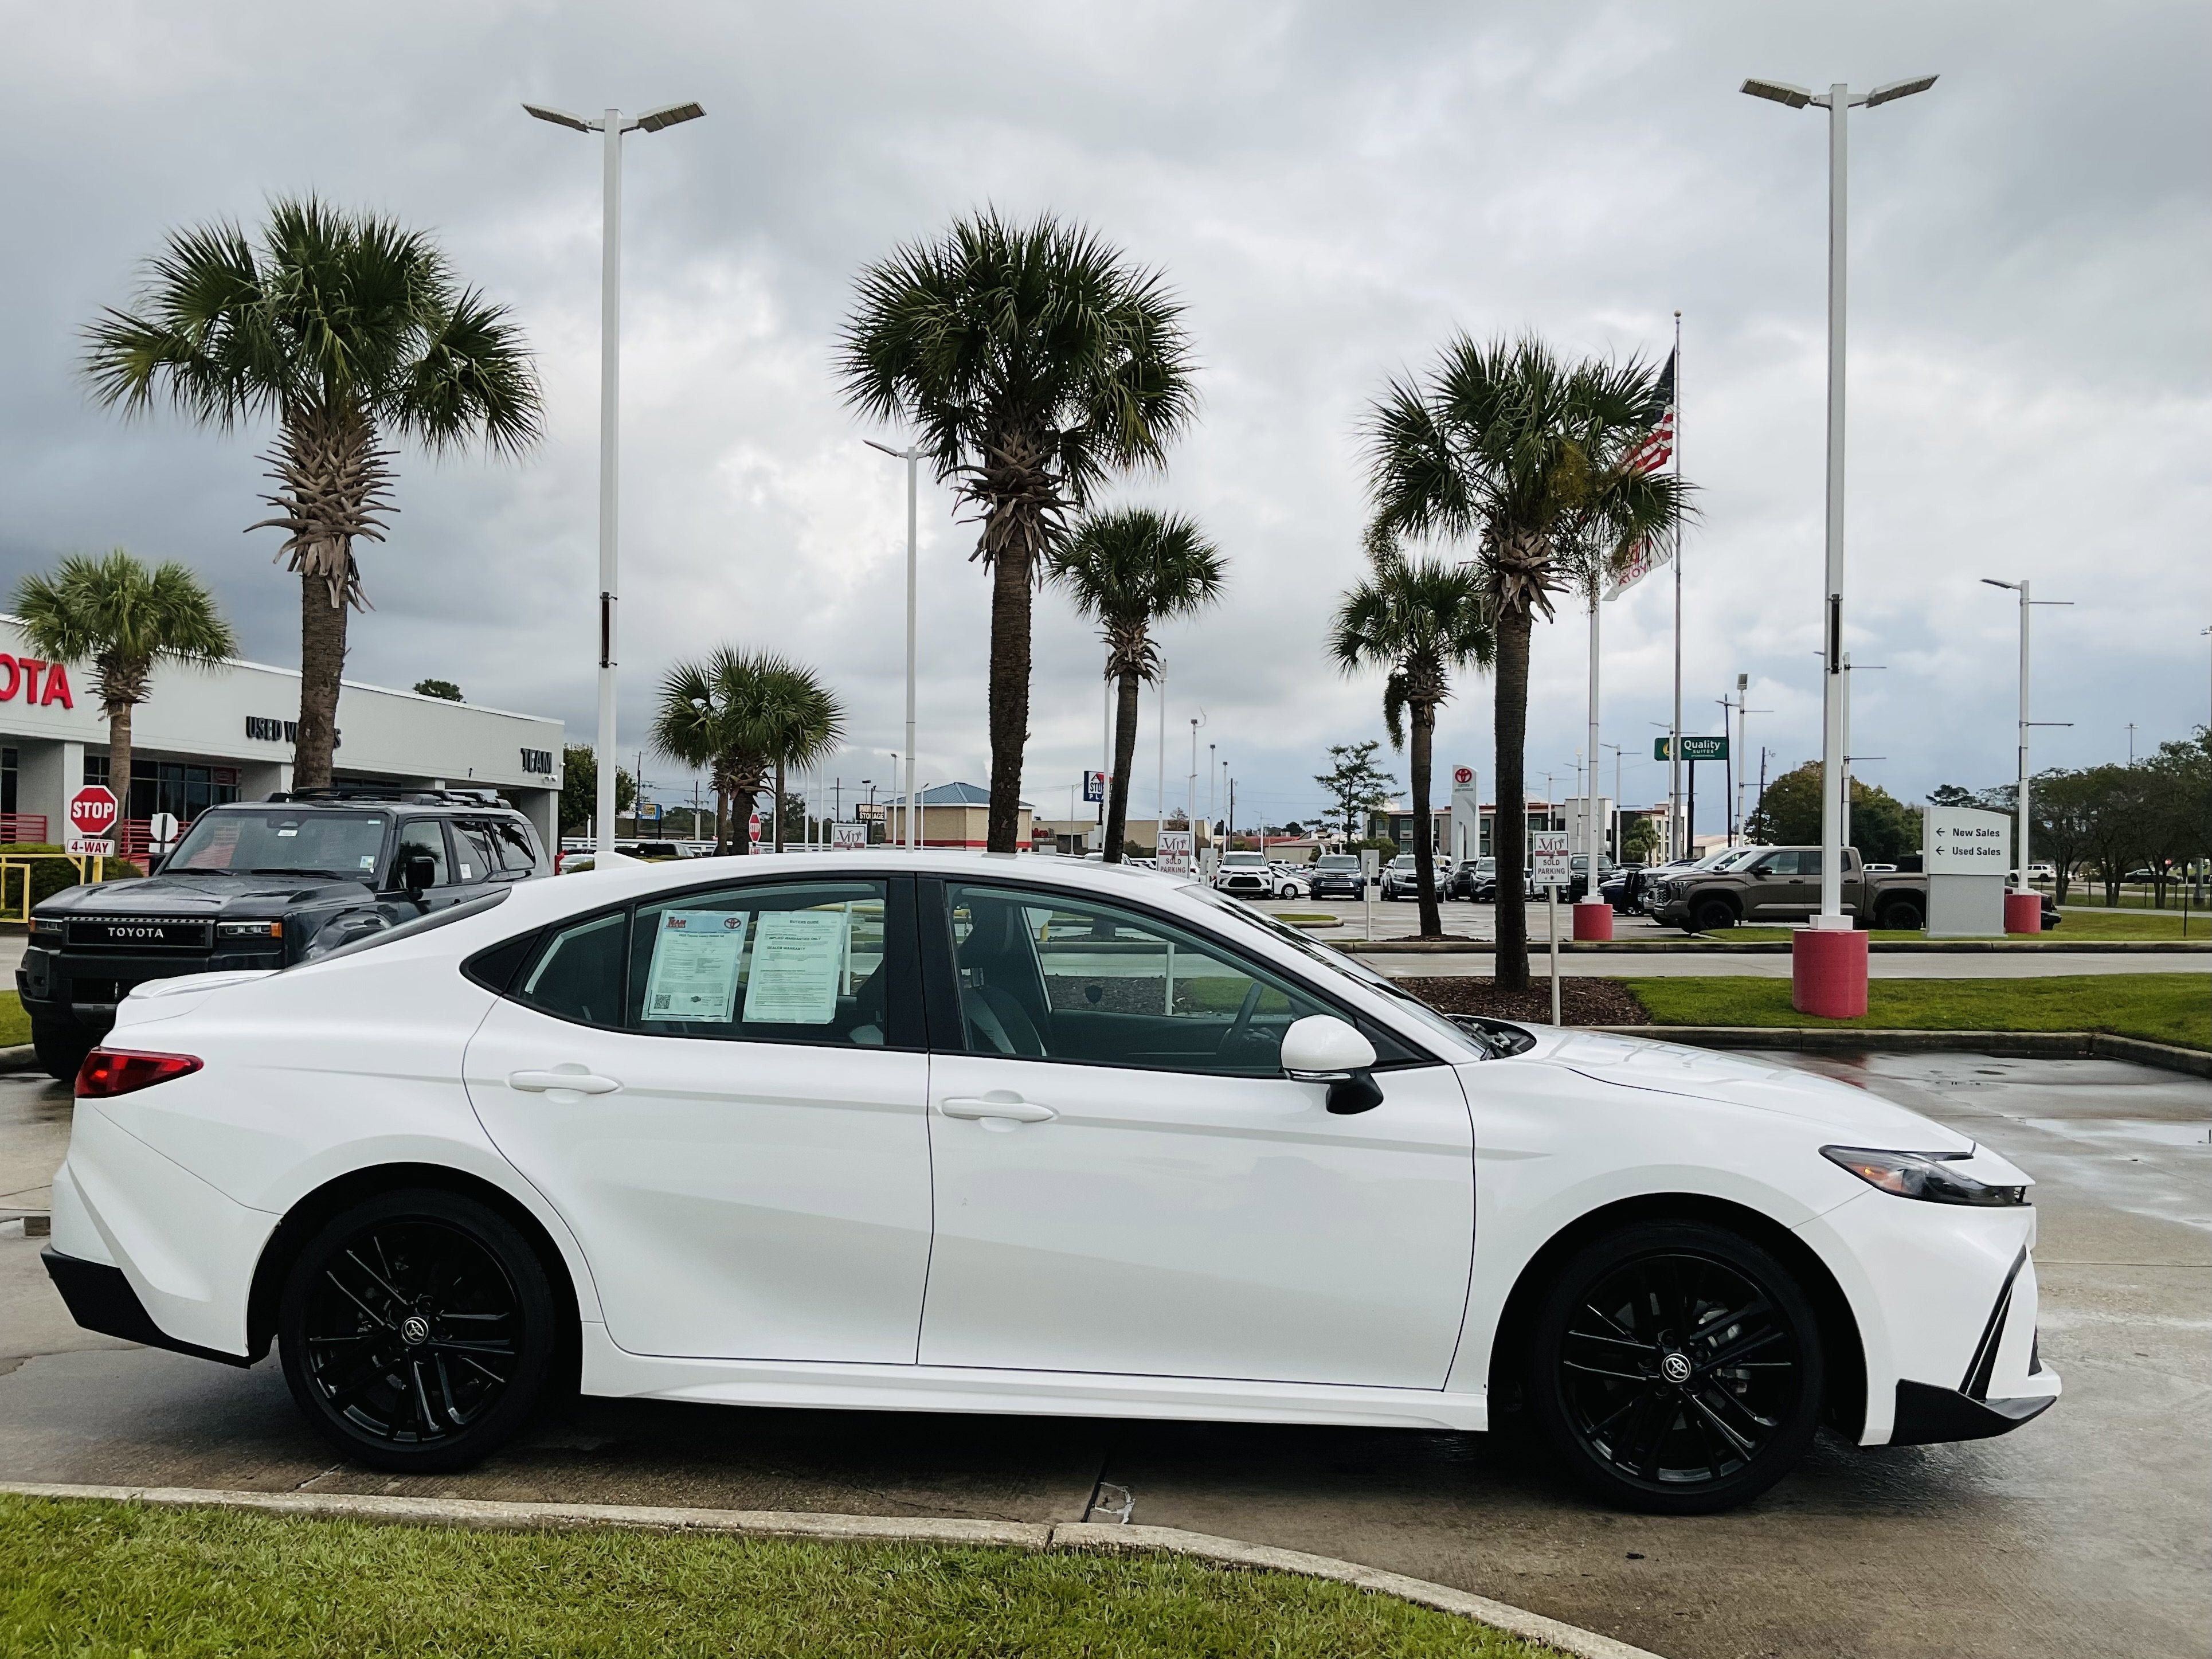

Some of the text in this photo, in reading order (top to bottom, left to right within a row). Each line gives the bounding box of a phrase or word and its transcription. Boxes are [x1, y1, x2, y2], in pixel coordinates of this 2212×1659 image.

[246, 716, 283, 741] USED
[1684, 740, 1721, 750] Quality
[520, 748, 552, 773] TEAM
[72, 801, 114, 819] STOP
[750, 823, 760, 833] STOP
[1953, 828, 2000, 837] New Sales
[72, 841, 108, 853] 4-WAY
[1952, 847, 2000, 855] Used Sales
[108, 927, 163, 938] TOYOTA
